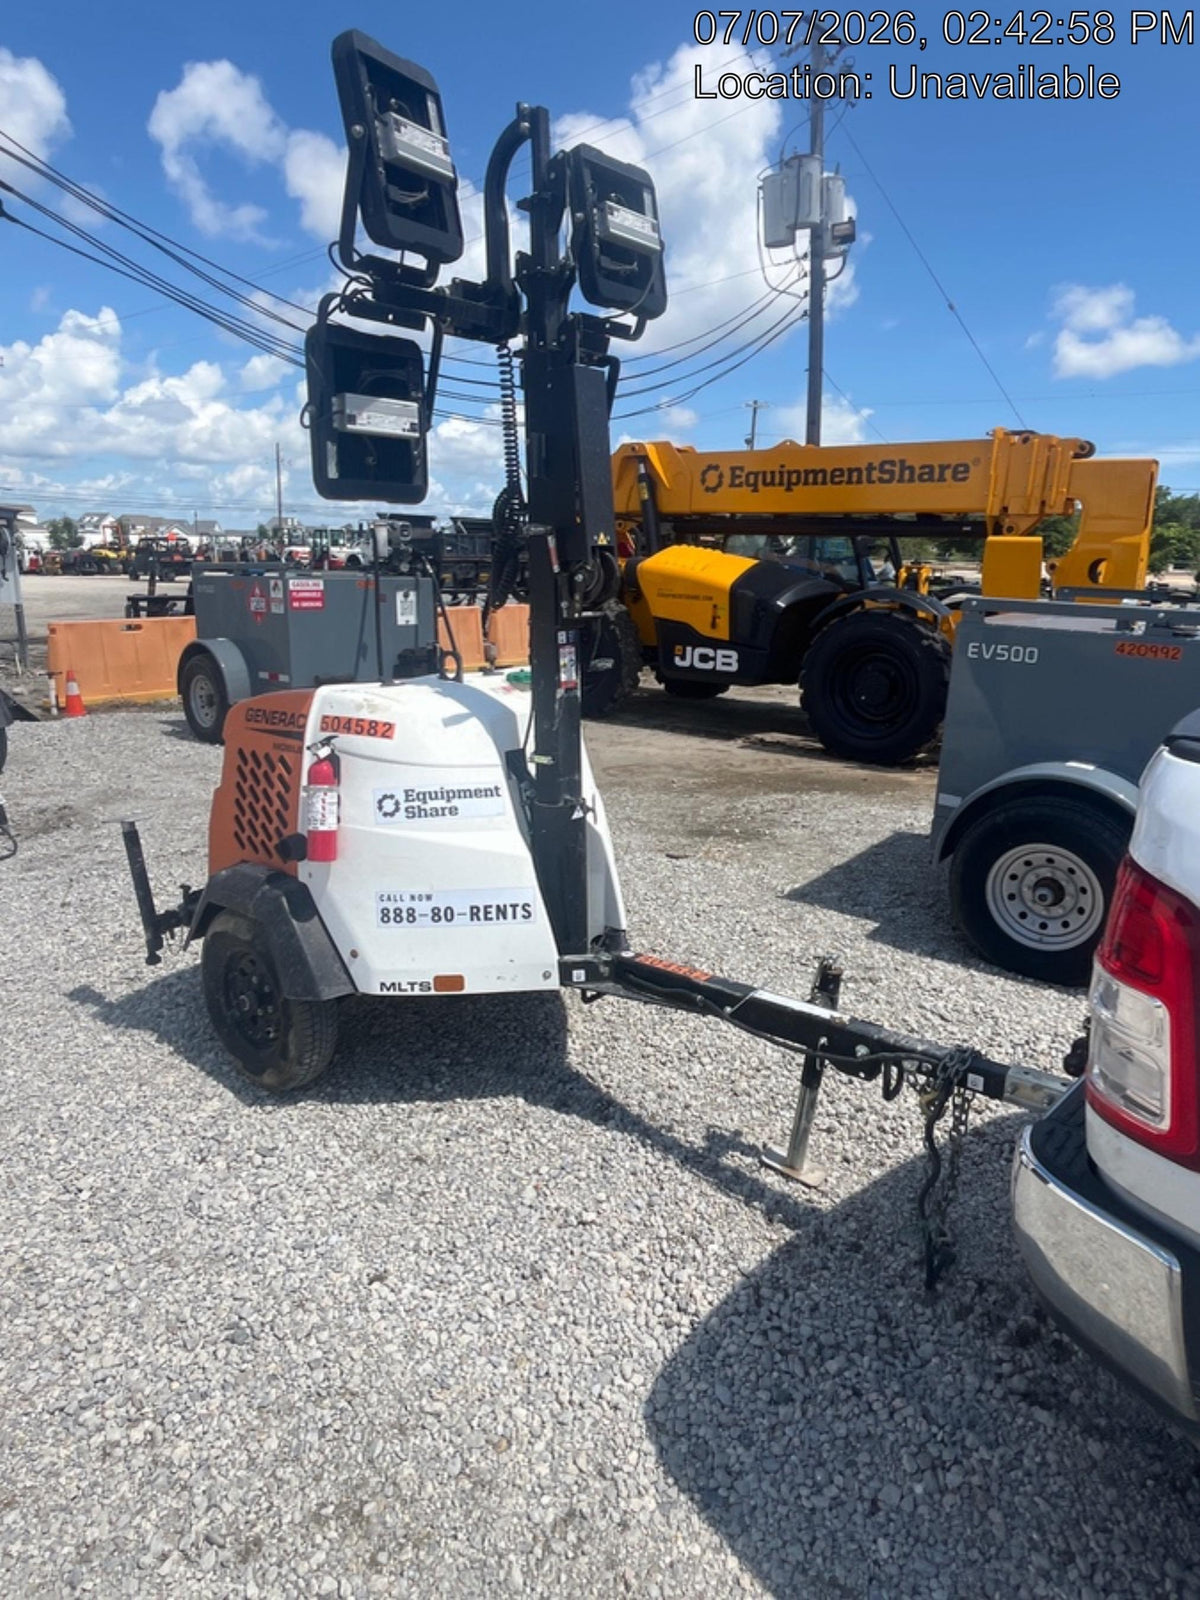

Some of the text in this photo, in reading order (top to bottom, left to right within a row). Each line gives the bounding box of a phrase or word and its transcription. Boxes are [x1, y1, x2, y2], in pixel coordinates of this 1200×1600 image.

[728, 459, 971, 493] EquipmentShare
[675, 646, 739, 671] JCB
[967, 642, 1039, 664] EV500
[1116, 643, 1181, 660] 420992
[245, 707, 306, 729] GENERAC
[403, 785, 502, 804] Equipment
[404, 804, 459, 820] Share
[378, 893, 433, 902] CALL NOW
[380, 902, 532, 924] 888-80-RENTS
[380, 981, 432, 992] MLTS
